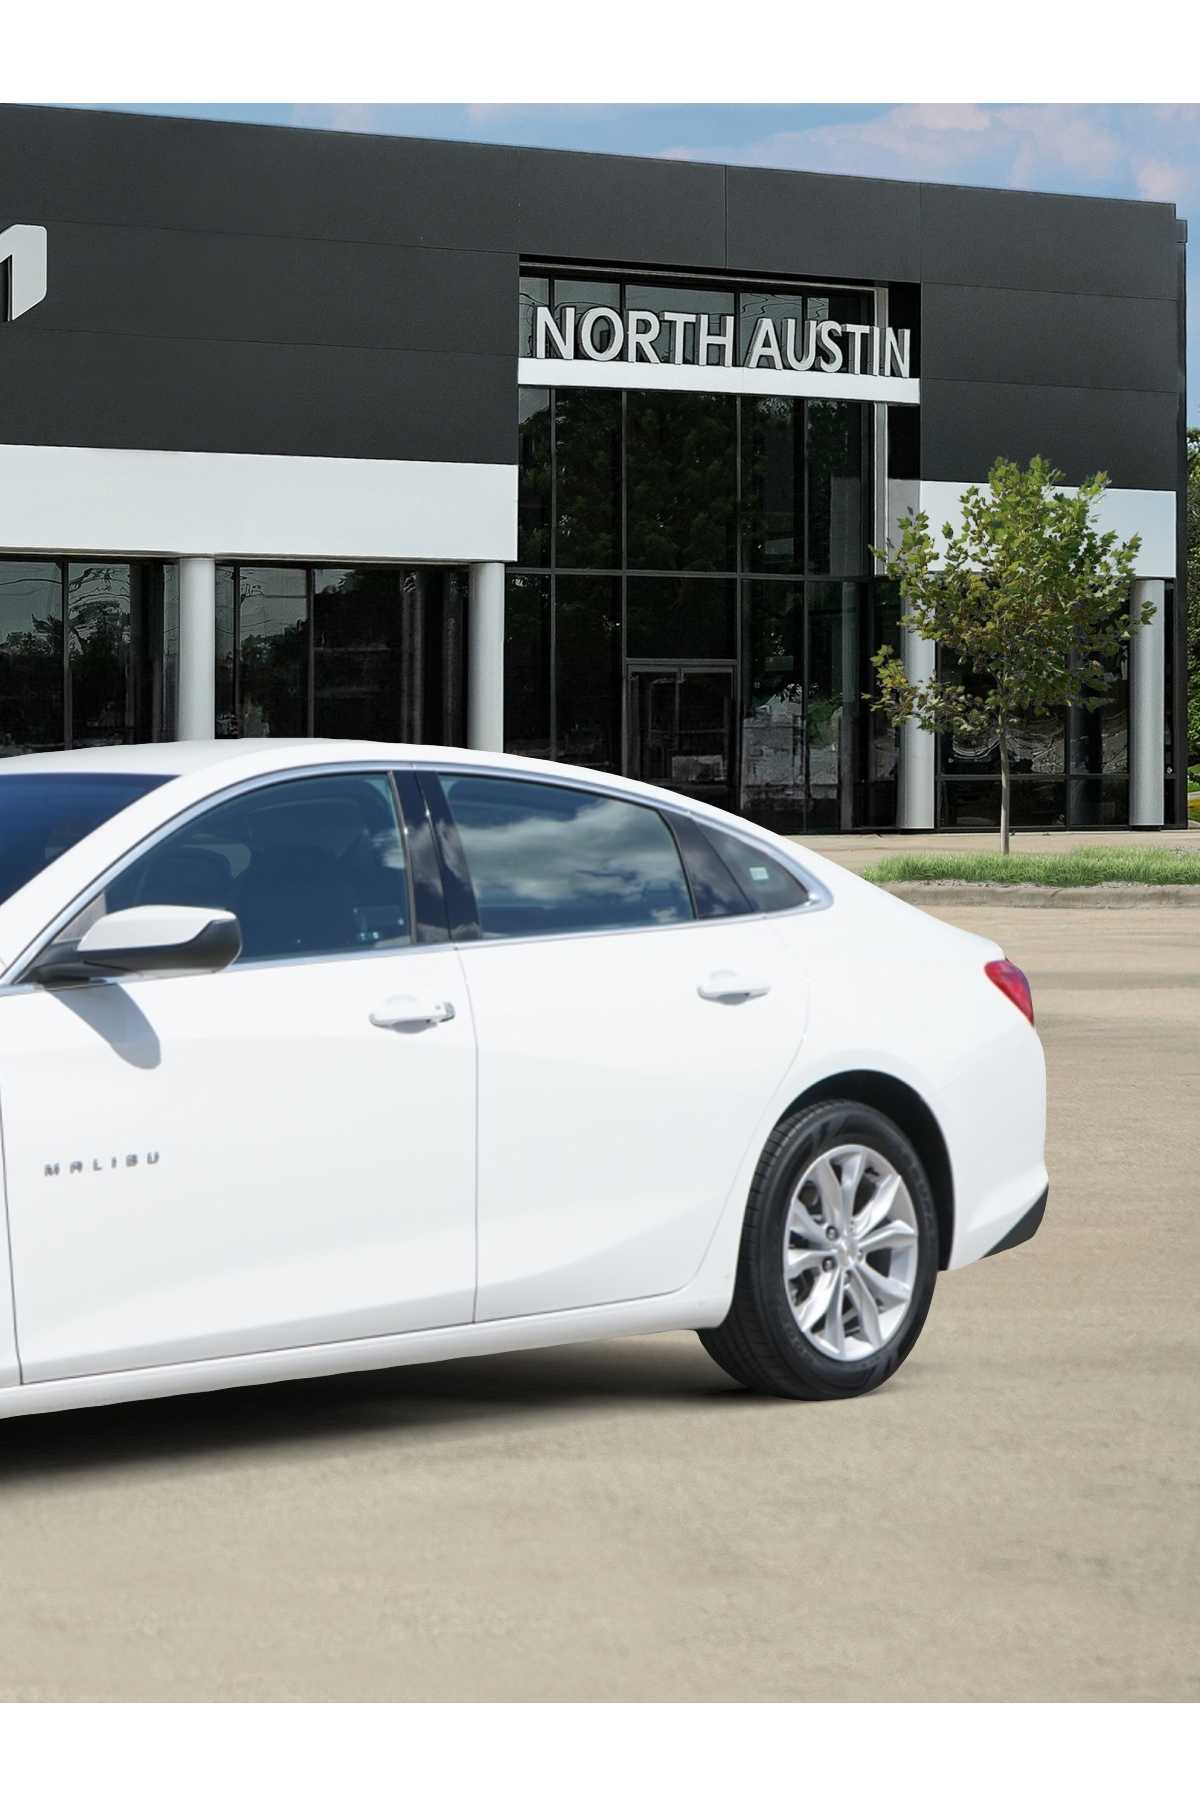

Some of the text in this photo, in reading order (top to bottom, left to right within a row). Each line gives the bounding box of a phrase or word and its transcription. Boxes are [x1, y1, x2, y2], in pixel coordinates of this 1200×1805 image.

[536, 306, 911, 378] NORTH AUSTIN
[43, 1151, 160, 1177] MALIBU
